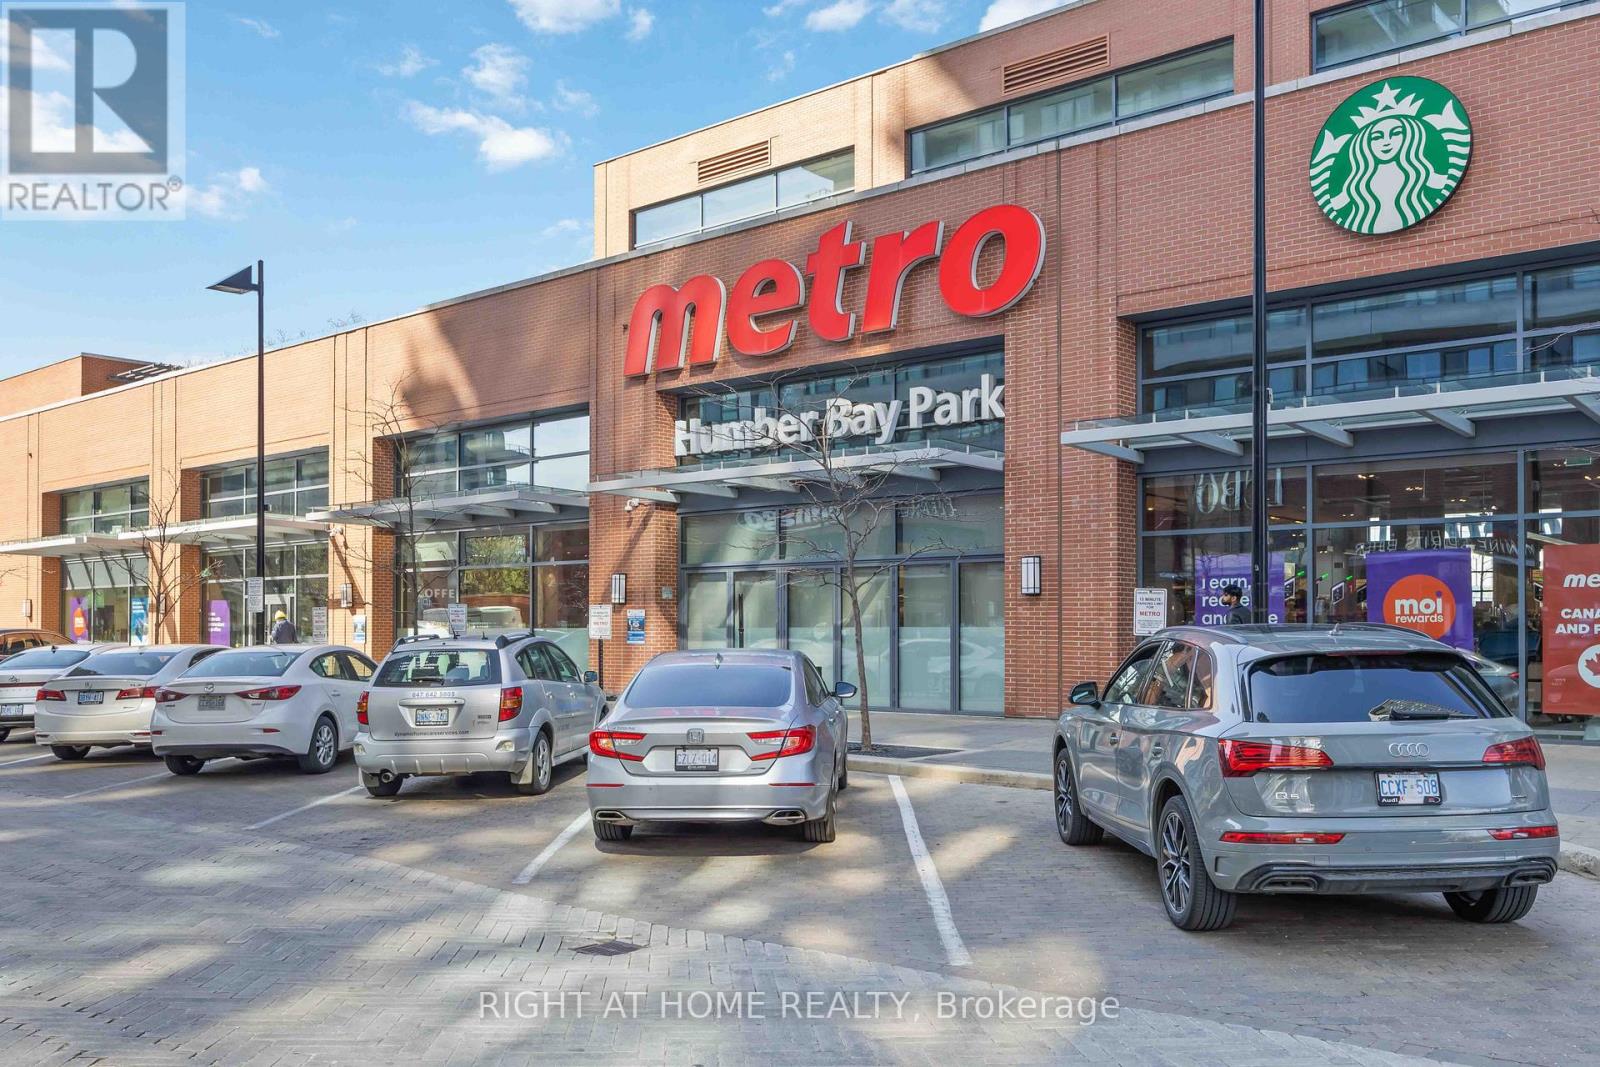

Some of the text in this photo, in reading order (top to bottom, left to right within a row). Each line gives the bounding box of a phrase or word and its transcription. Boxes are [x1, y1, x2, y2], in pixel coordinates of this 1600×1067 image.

[623, 203, 1046, 377] metro
[674, 373, 1005, 456] Humber Bay Park
[1394, 591, 1443, 615] moi
[1395, 613, 1444, 623] rewards
[1555, 623, 1590, 634] AND
[1381, 779, 1438, 796] CCXF 508
